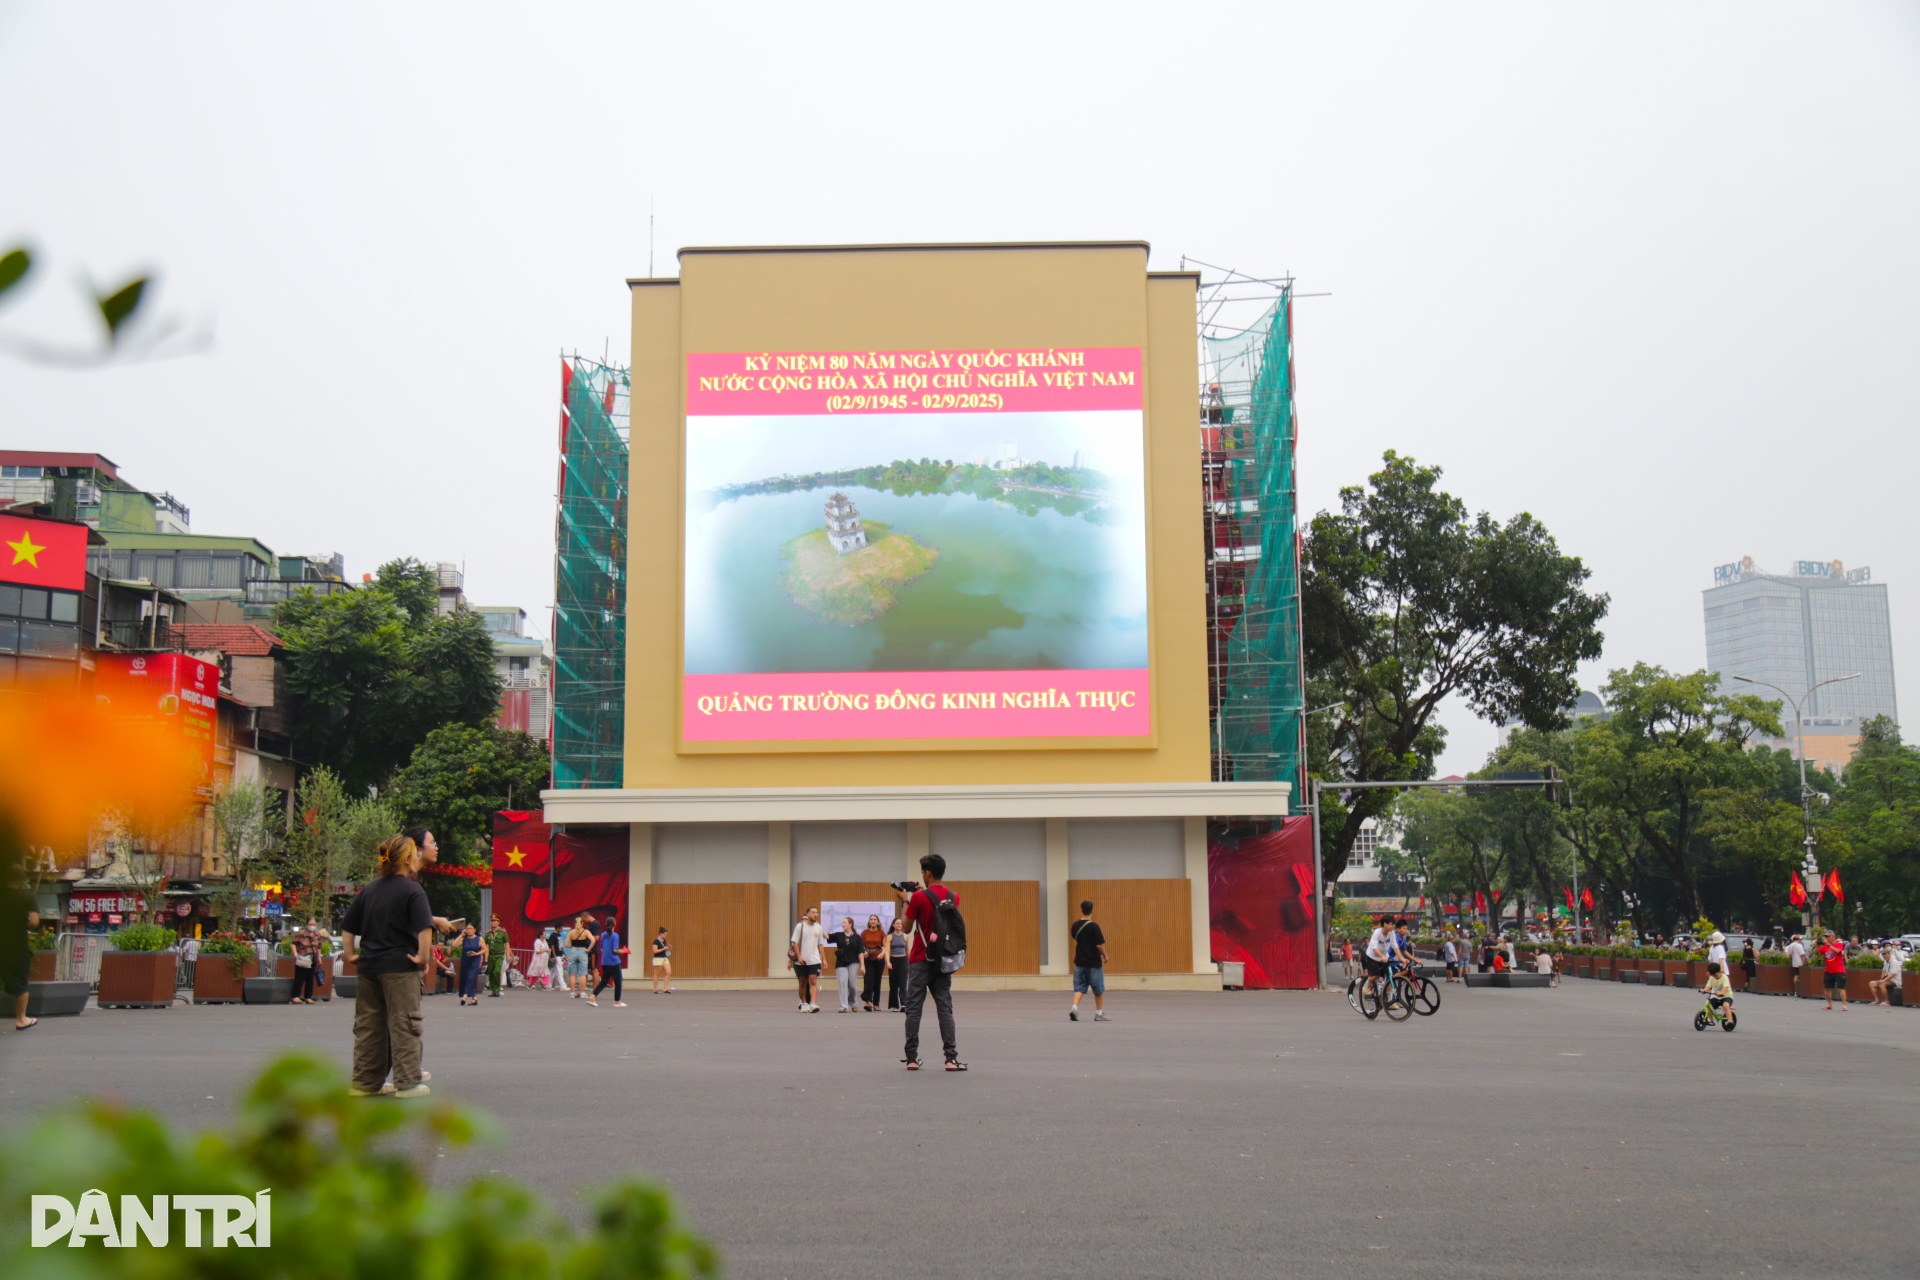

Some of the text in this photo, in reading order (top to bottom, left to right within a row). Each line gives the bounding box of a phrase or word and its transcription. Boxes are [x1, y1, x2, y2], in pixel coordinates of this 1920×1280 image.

[745, 349, 1084, 373] KỶ NIỆM 80 NĂM NGÀY QUỐC KHÁNH
[700, 370, 1135, 394] NƯỚC CỘNG HÒA XÃ HỘI CHỦ NGHĨA VIỆT NAM
[827, 394, 907, 412] (02/9/1945
[922, 393, 1003, 410] 02/9/2025)
[1714, 561, 1742, 581] BIDV
[1798, 561, 1831, 576] BIDV
[202, 694, 216, 709] HOA
[698, 688, 1136, 715] QUẢNG TRƯỜNG ĐÔNG KINH NGHĨA THỤC
[69, 899, 84, 913] SIM
[85, 898, 96, 912] 5G
[97, 898, 116, 912] FREE
[118, 898, 137, 912] DATA
